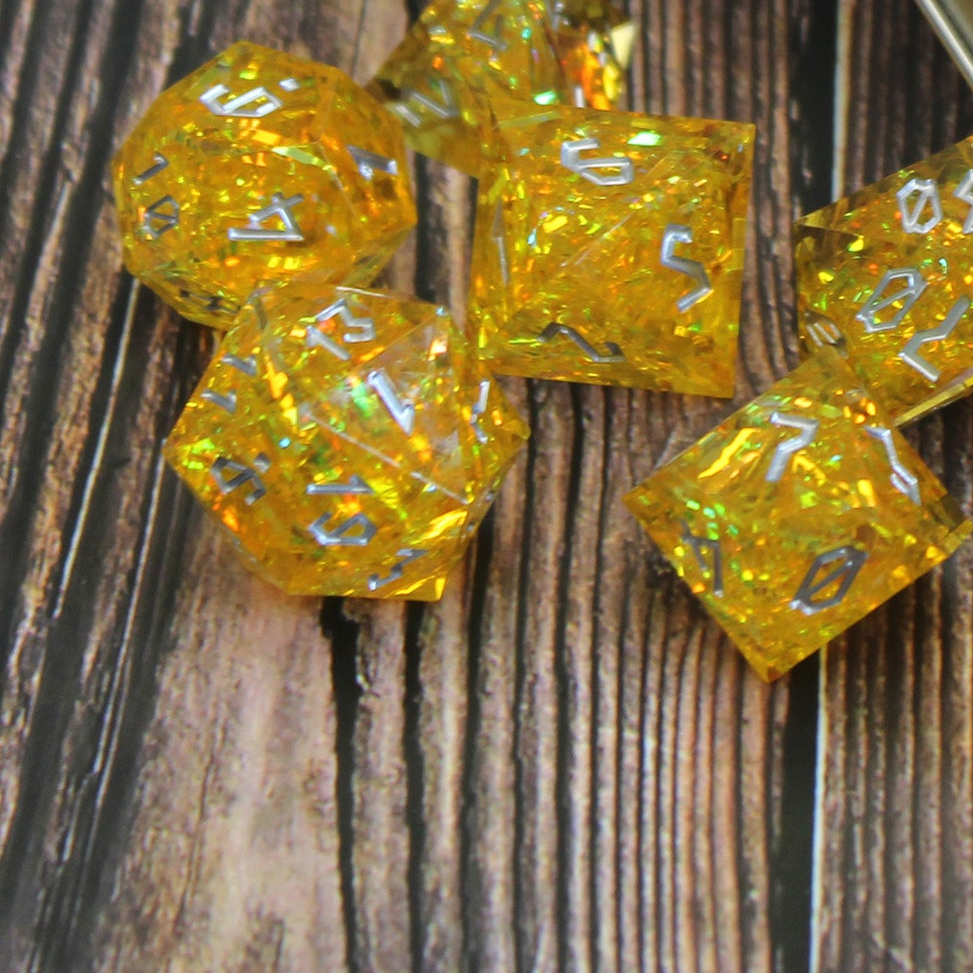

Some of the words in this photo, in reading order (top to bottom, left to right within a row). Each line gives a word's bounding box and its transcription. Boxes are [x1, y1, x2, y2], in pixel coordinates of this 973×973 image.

[560, 137, 634, 186] 6
[229, 192, 304, 241] 4
[660, 222, 714, 314] 5
[766, 411, 819, 483] 7
